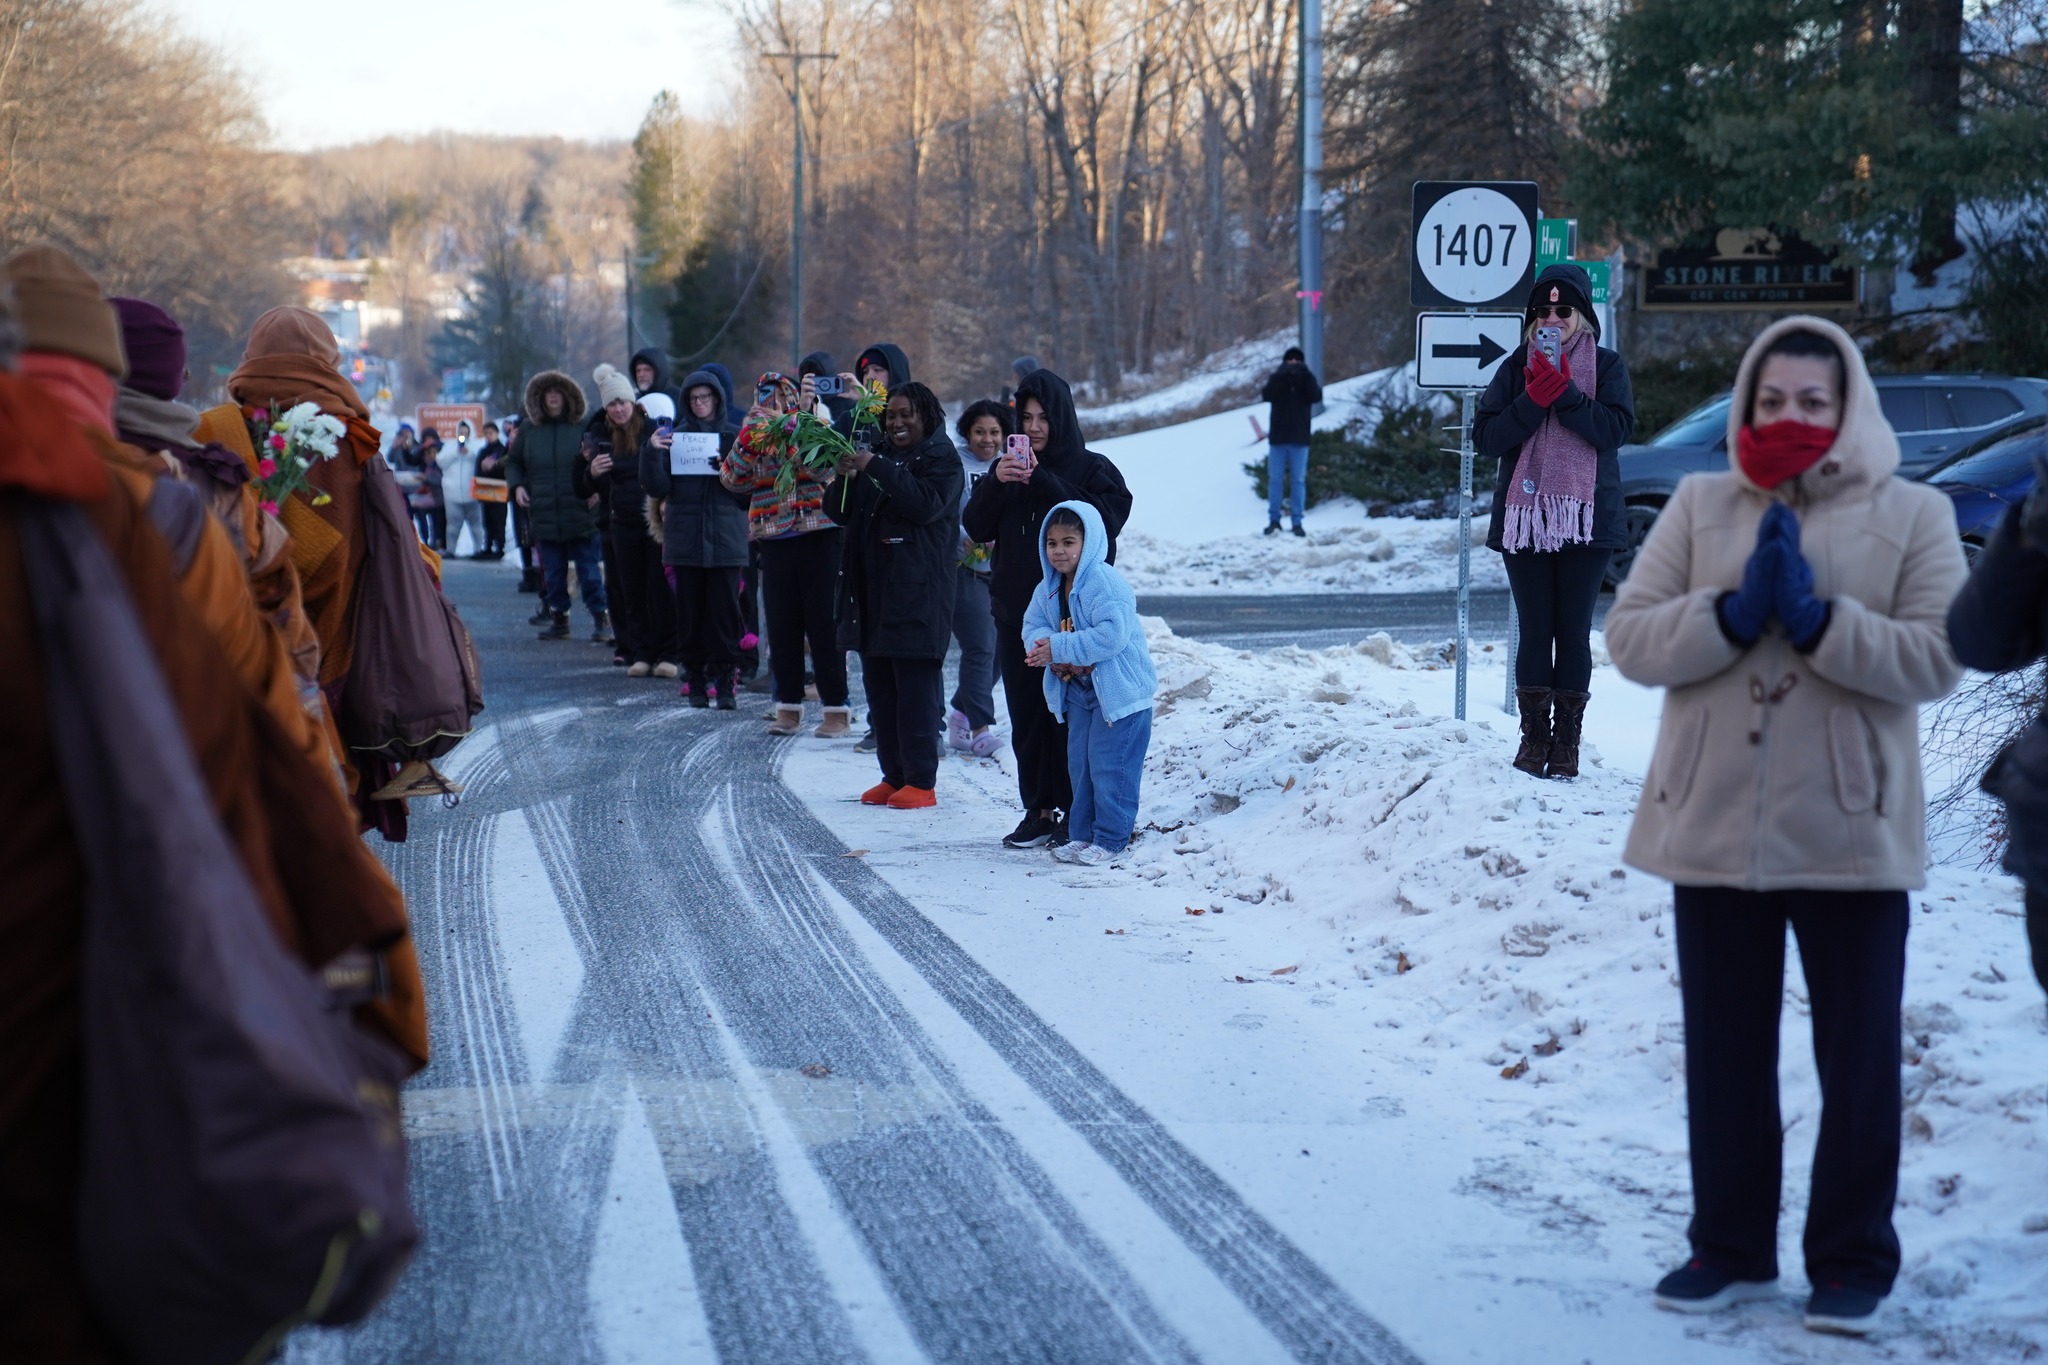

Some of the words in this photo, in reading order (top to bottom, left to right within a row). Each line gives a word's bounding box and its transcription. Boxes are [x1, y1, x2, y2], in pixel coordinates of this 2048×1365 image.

[1433, 223, 1517, 267] 1407
[1541, 225, 1561, 261] Hwy
[1664, 266, 1741, 285] STONE
[1591, 288, 1605, 298] 407
[1759, 288, 1806, 300] POINE
[682, 434, 707, 443] PEACE
[680, 456, 707, 465] UNITY
